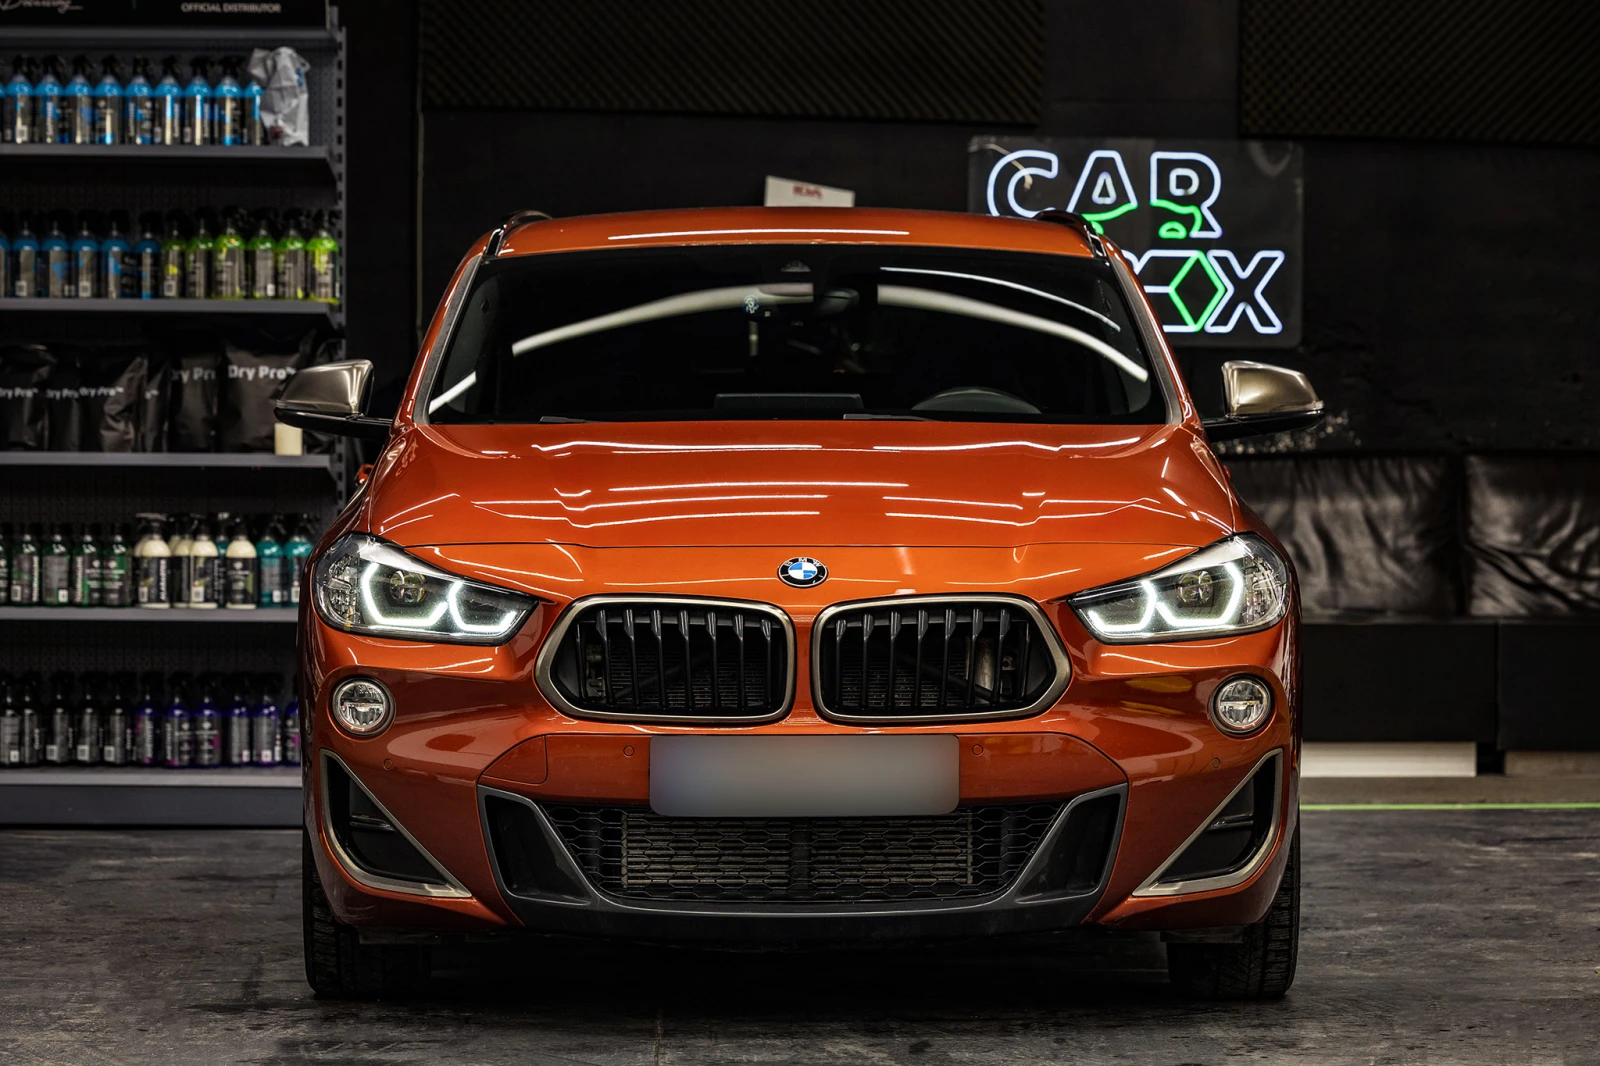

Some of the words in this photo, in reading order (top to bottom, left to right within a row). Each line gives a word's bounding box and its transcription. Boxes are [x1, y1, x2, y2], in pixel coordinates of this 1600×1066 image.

[180, 2, 221, 13] OFFICIAL
[222, 2, 282, 14] DISTRIBUTOR
[987, 149, 1223, 239] CAR
[1121, 249, 1285, 334] OX
[227, 364, 256, 381] Dry
[784, 557, 822, 567] BMW
